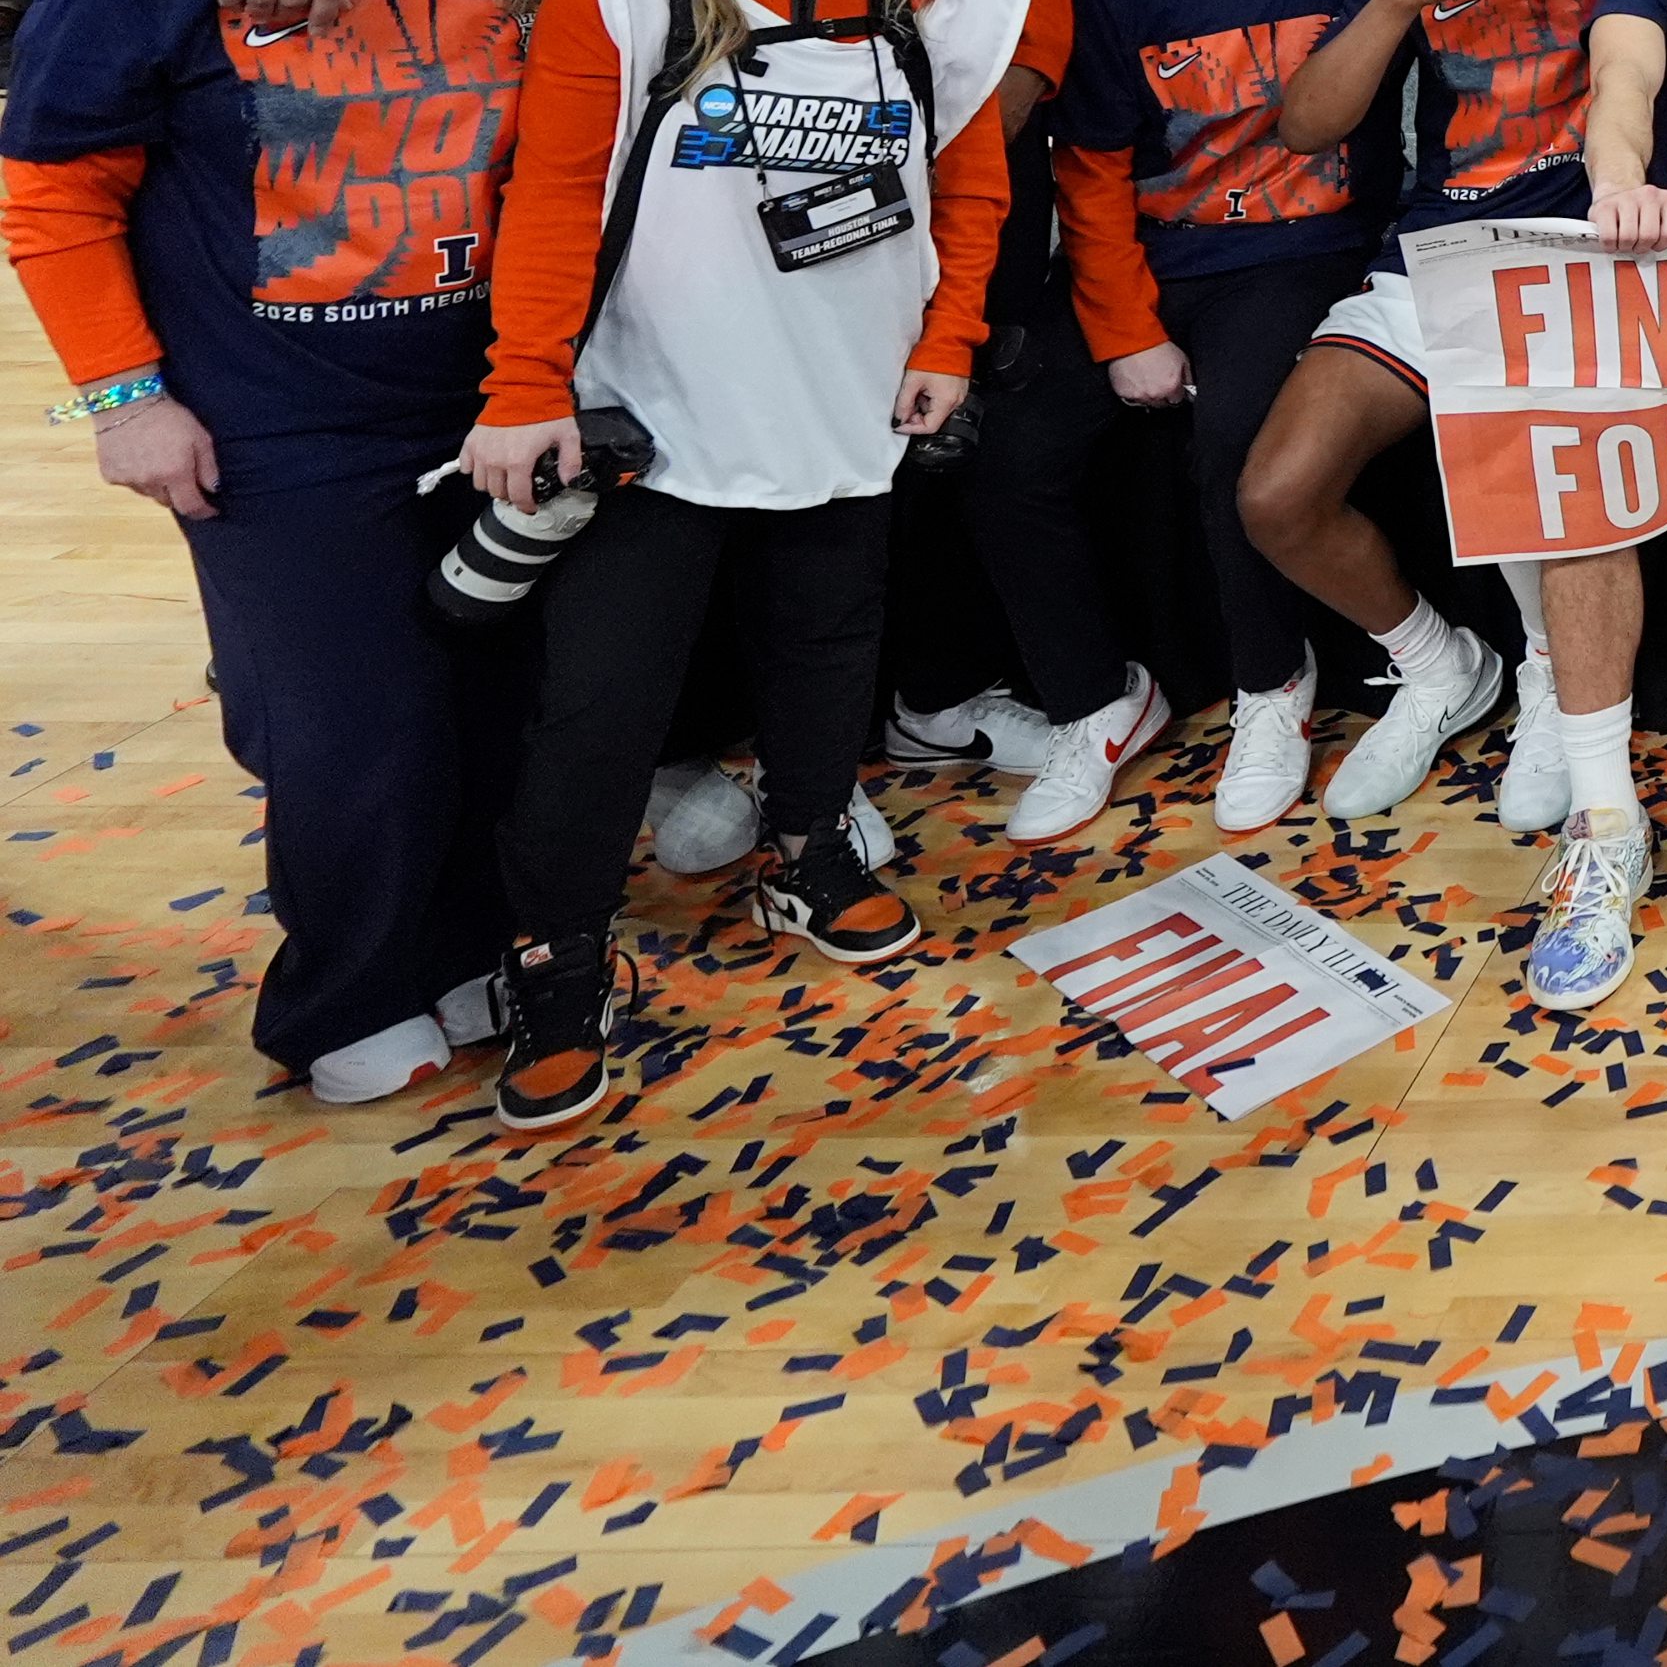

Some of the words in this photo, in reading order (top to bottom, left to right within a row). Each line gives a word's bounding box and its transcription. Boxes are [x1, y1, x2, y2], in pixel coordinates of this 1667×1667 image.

[733, 93, 864, 132] MARCH
[741, 126, 910, 166] MADNESS
[790, 225, 872, 261] TEAM-REGIONAL
[872, 215, 900, 235] FINAL
[828, 215, 871, 237] HOUSTON
[252, 300, 314, 323] 2026
[324, 294, 411, 323] SOUTH
[1220, 881, 1273, 919] THE
[1271, 908, 1335, 963] DAILY
[1039, 911, 1332, 1100] FINAL
